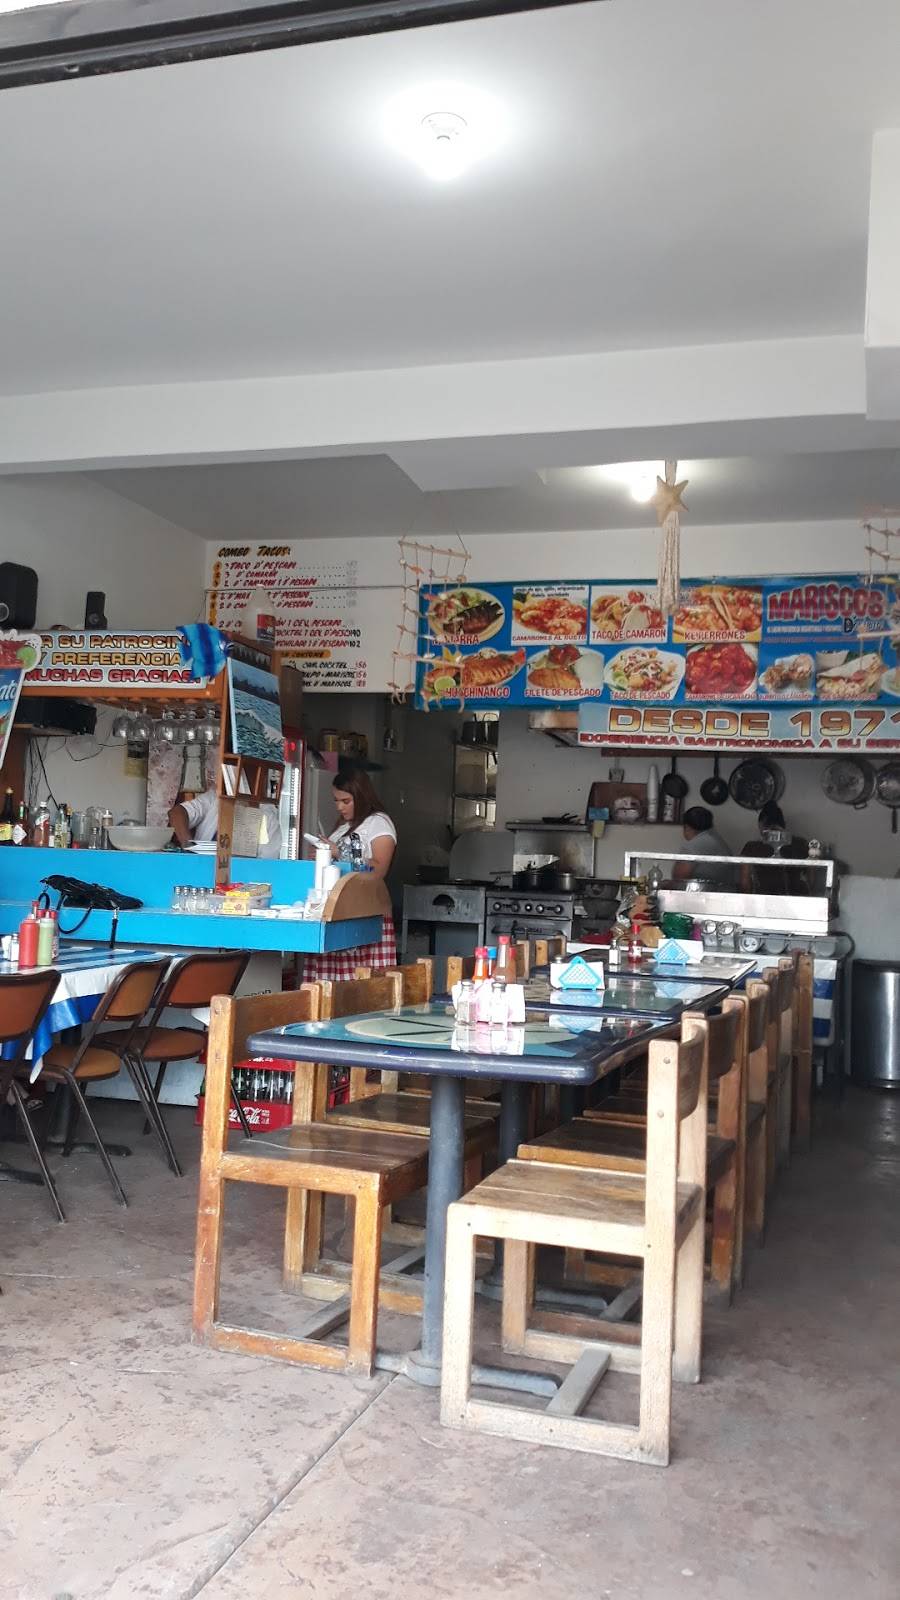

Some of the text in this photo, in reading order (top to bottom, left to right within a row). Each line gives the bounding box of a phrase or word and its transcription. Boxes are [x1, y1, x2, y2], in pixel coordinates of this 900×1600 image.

[768, 583, 884, 619] MARISCOS
[58, 635, 85, 648] SU
[52, 652, 181, 666] PREFERENCIA
[25, 668, 103, 682] MUCHAS
[609, 707, 769, 737] DESDE
[820, 738, 833, 748] A
